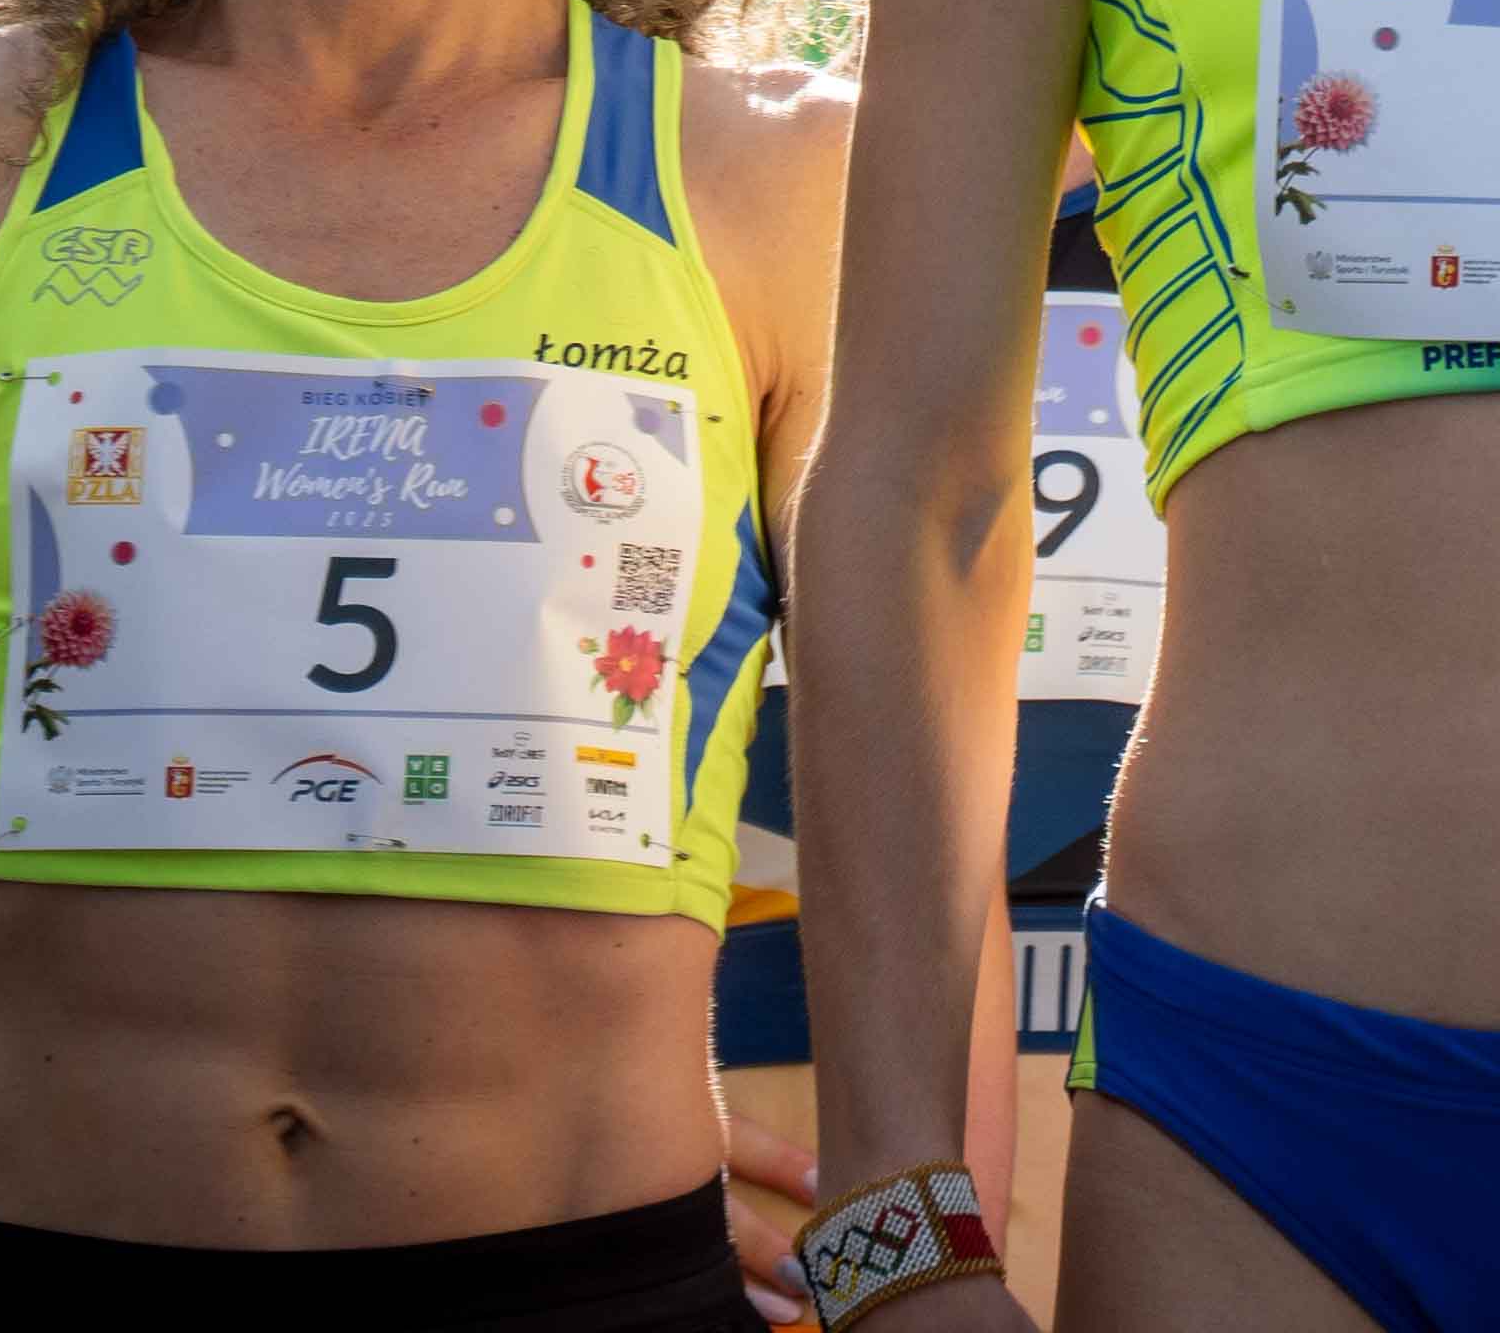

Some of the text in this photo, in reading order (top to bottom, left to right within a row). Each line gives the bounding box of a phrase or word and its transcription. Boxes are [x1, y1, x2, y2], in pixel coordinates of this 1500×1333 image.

[533, 333, 691, 381] Łomża
[301, 390, 350, 406] BIEG
[299, 414, 429, 462] IRENA
[69, 479, 140, 501] PZLA
[253, 462, 469, 509] Women's Run
[306, 555, 399, 695] 5
[289, 779, 360, 802] PGE
